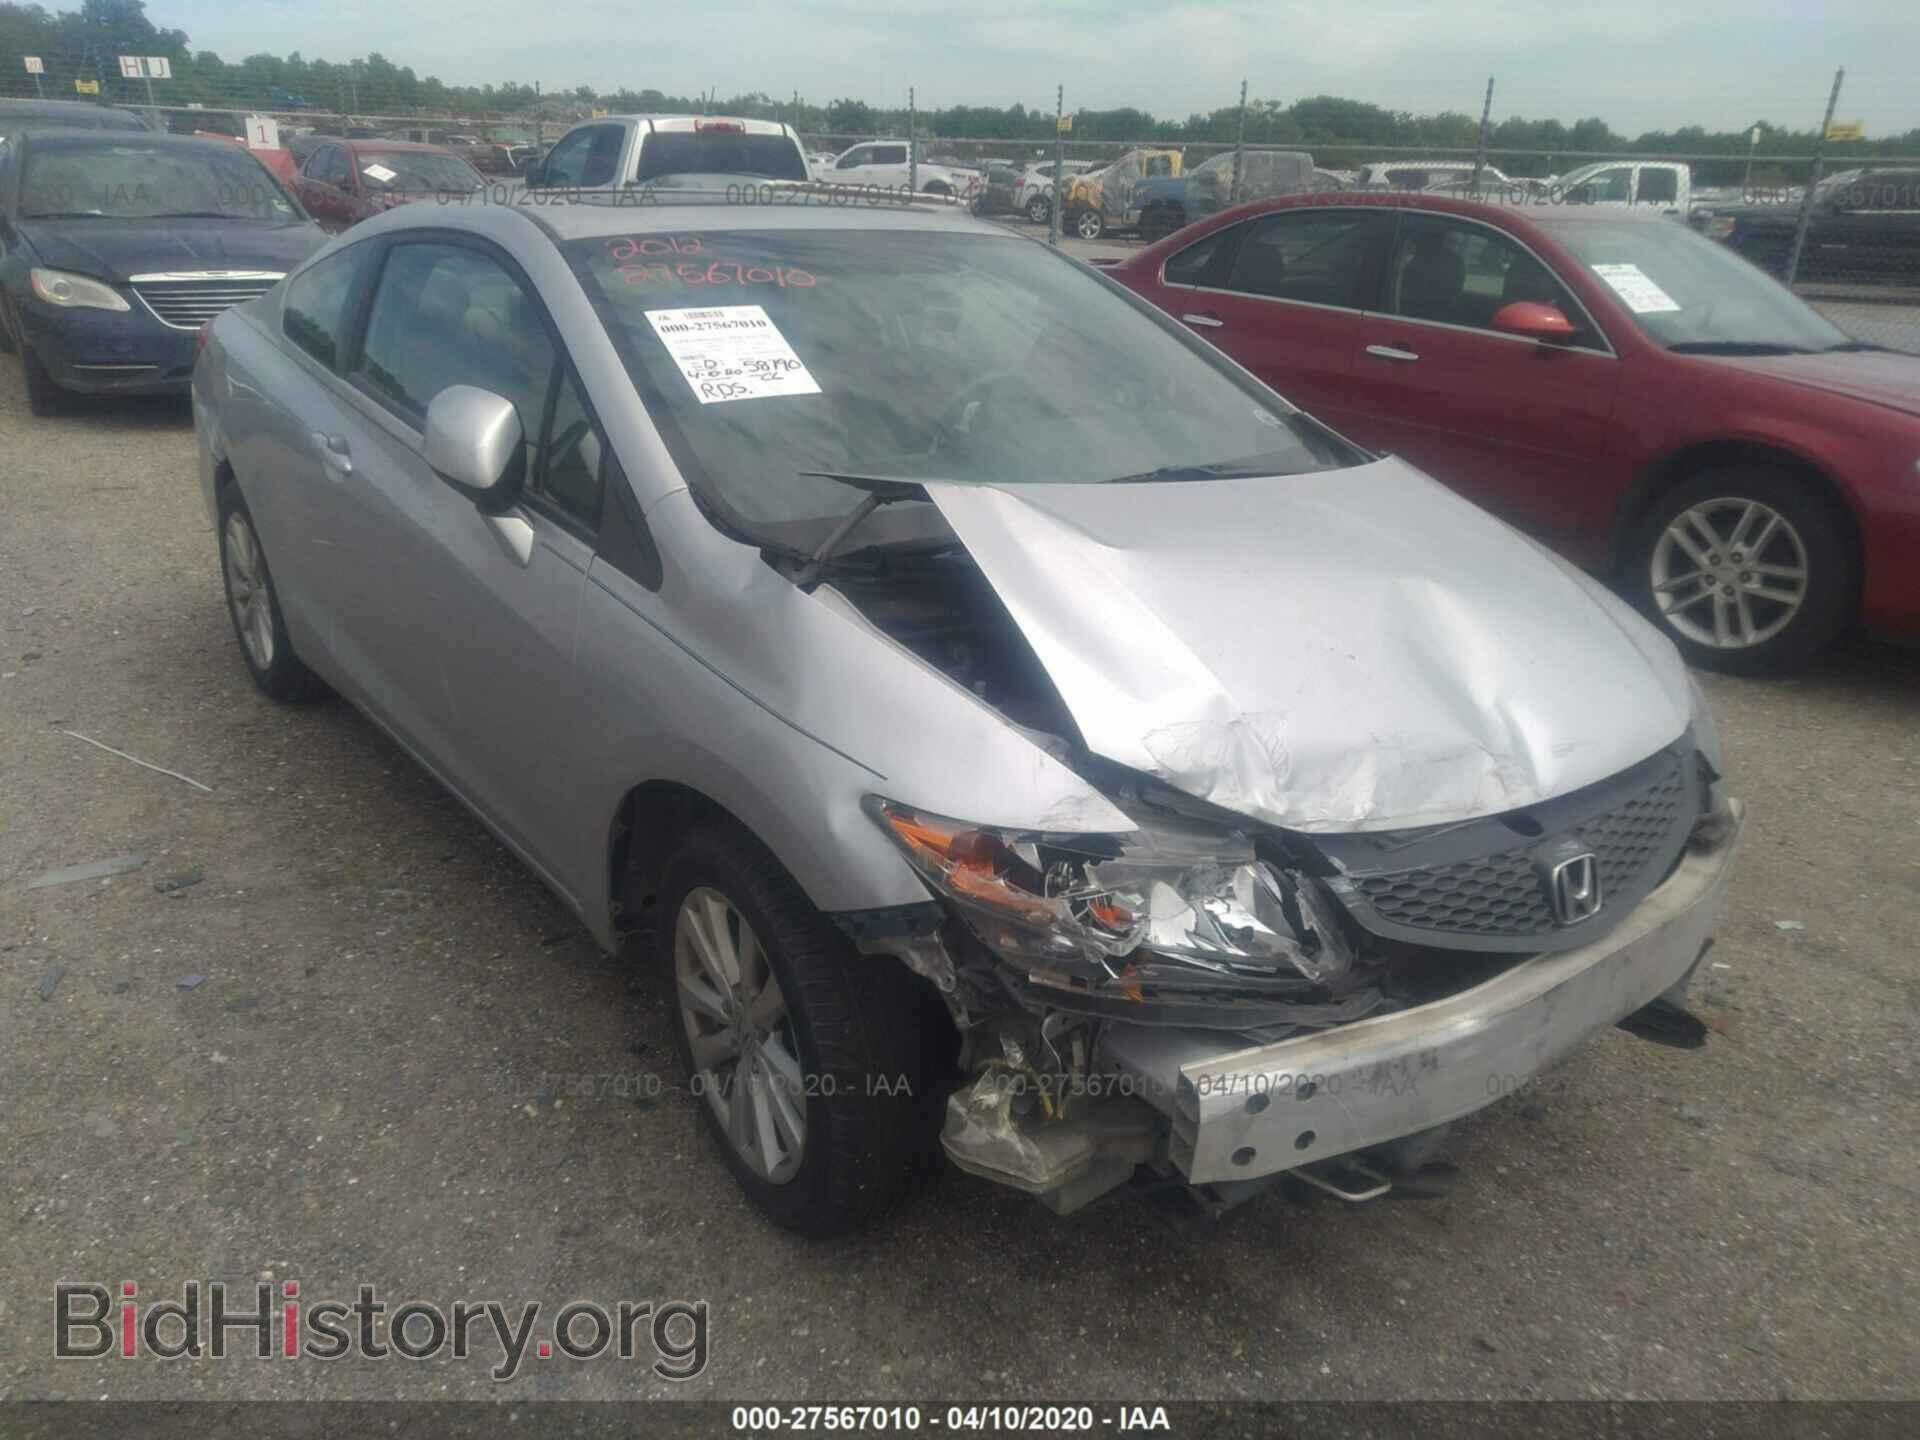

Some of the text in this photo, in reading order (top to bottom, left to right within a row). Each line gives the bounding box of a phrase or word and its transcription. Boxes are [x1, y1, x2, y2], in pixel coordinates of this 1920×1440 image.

[122, 58, 140, 76] H
[257, 125, 270, 144] 1
[608, 237, 704, 260] 2012
[616, 261, 817, 288] 27567010
[660, 319, 767, 334] 000-27567010
